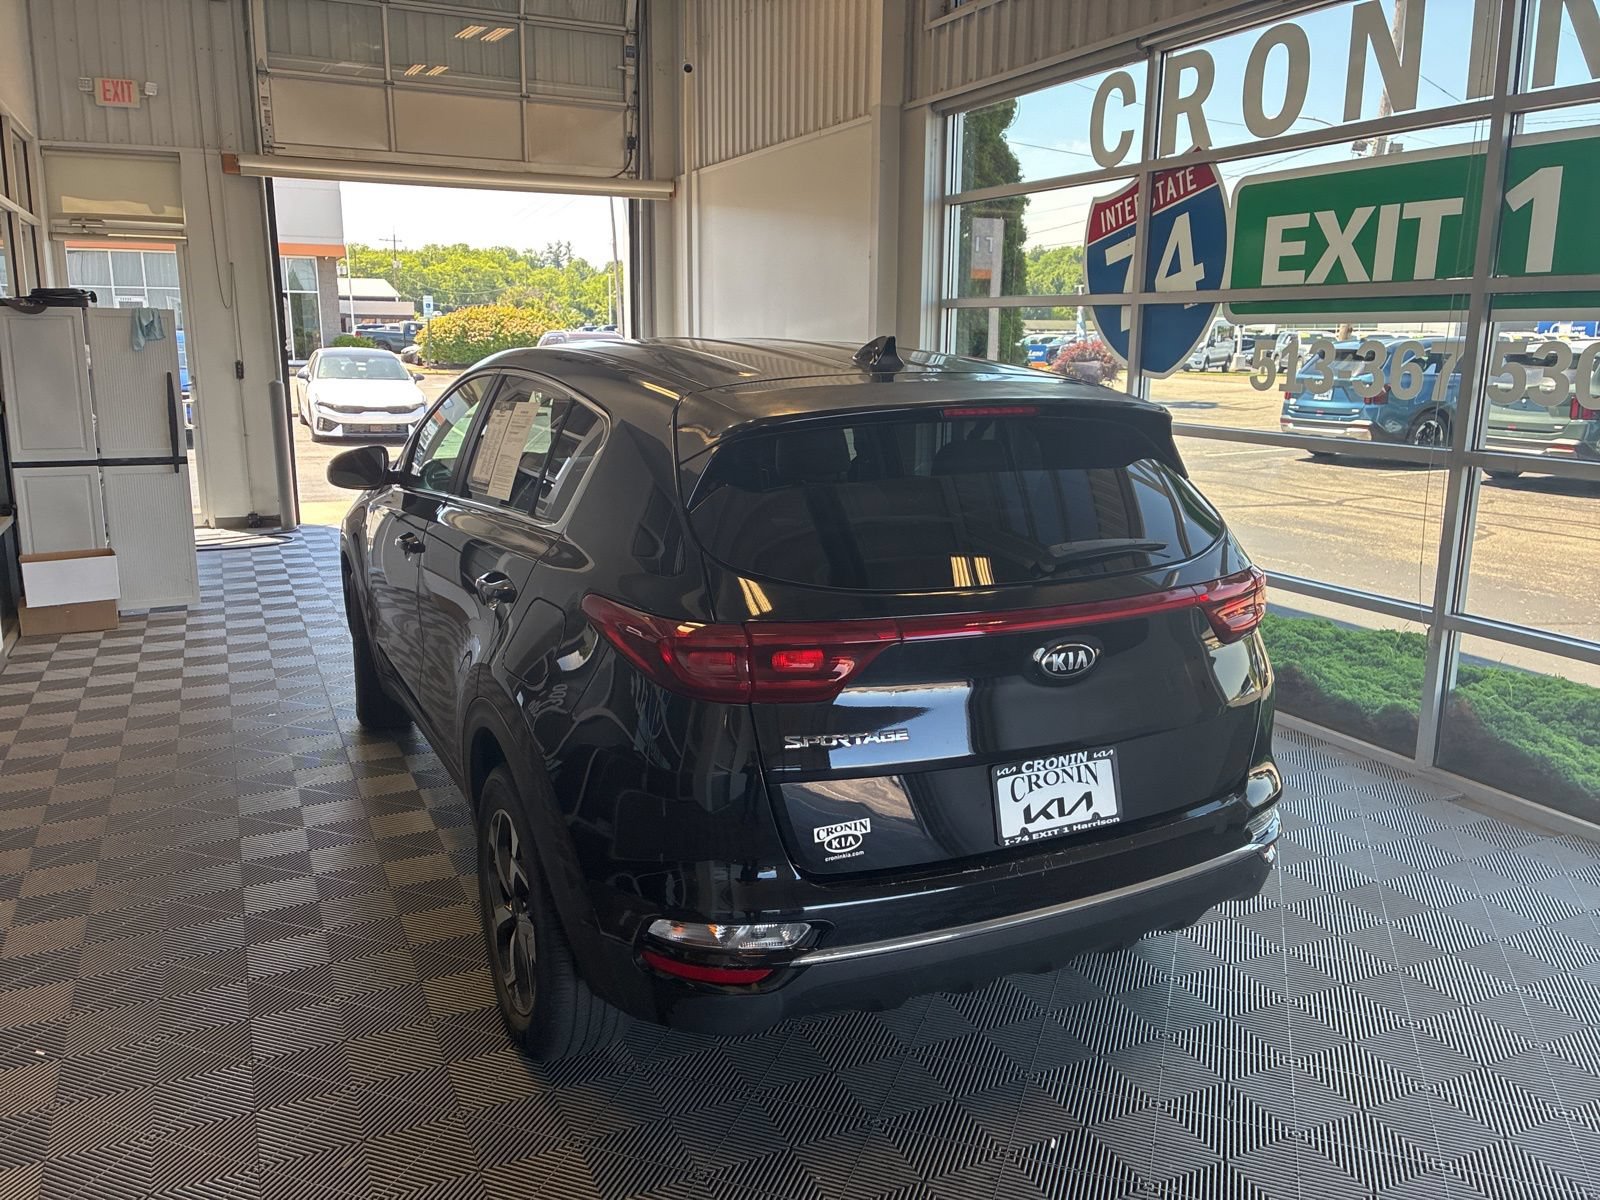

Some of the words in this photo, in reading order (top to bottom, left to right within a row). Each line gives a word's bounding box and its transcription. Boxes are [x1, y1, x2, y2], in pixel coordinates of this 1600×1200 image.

[101, 79, 133, 103] EXIT
[1100, 166, 1197, 233] INTETATE
[1261, 198, 1464, 287] EXIT
[1505, 165, 1564, 273] 1
[1051, 650, 1088, 672] KIA
[784, 728, 909, 749] SPORTAGE
[1021, 751, 1088, 773] CRONIN
[1010, 761, 1100, 803] CRONIN
[1023, 790, 1094, 825] KIA
[816, 819, 869, 841] CRONIN
[1004, 835, 1030, 847] I-74
[1032, 829, 1061, 841] EXIT
[1062, 826, 1071, 834] 1
[1073, 816, 1121, 831] Harrison
[831, 834, 857, 850] KIA
[824, 849, 866, 862] croninkia.com
